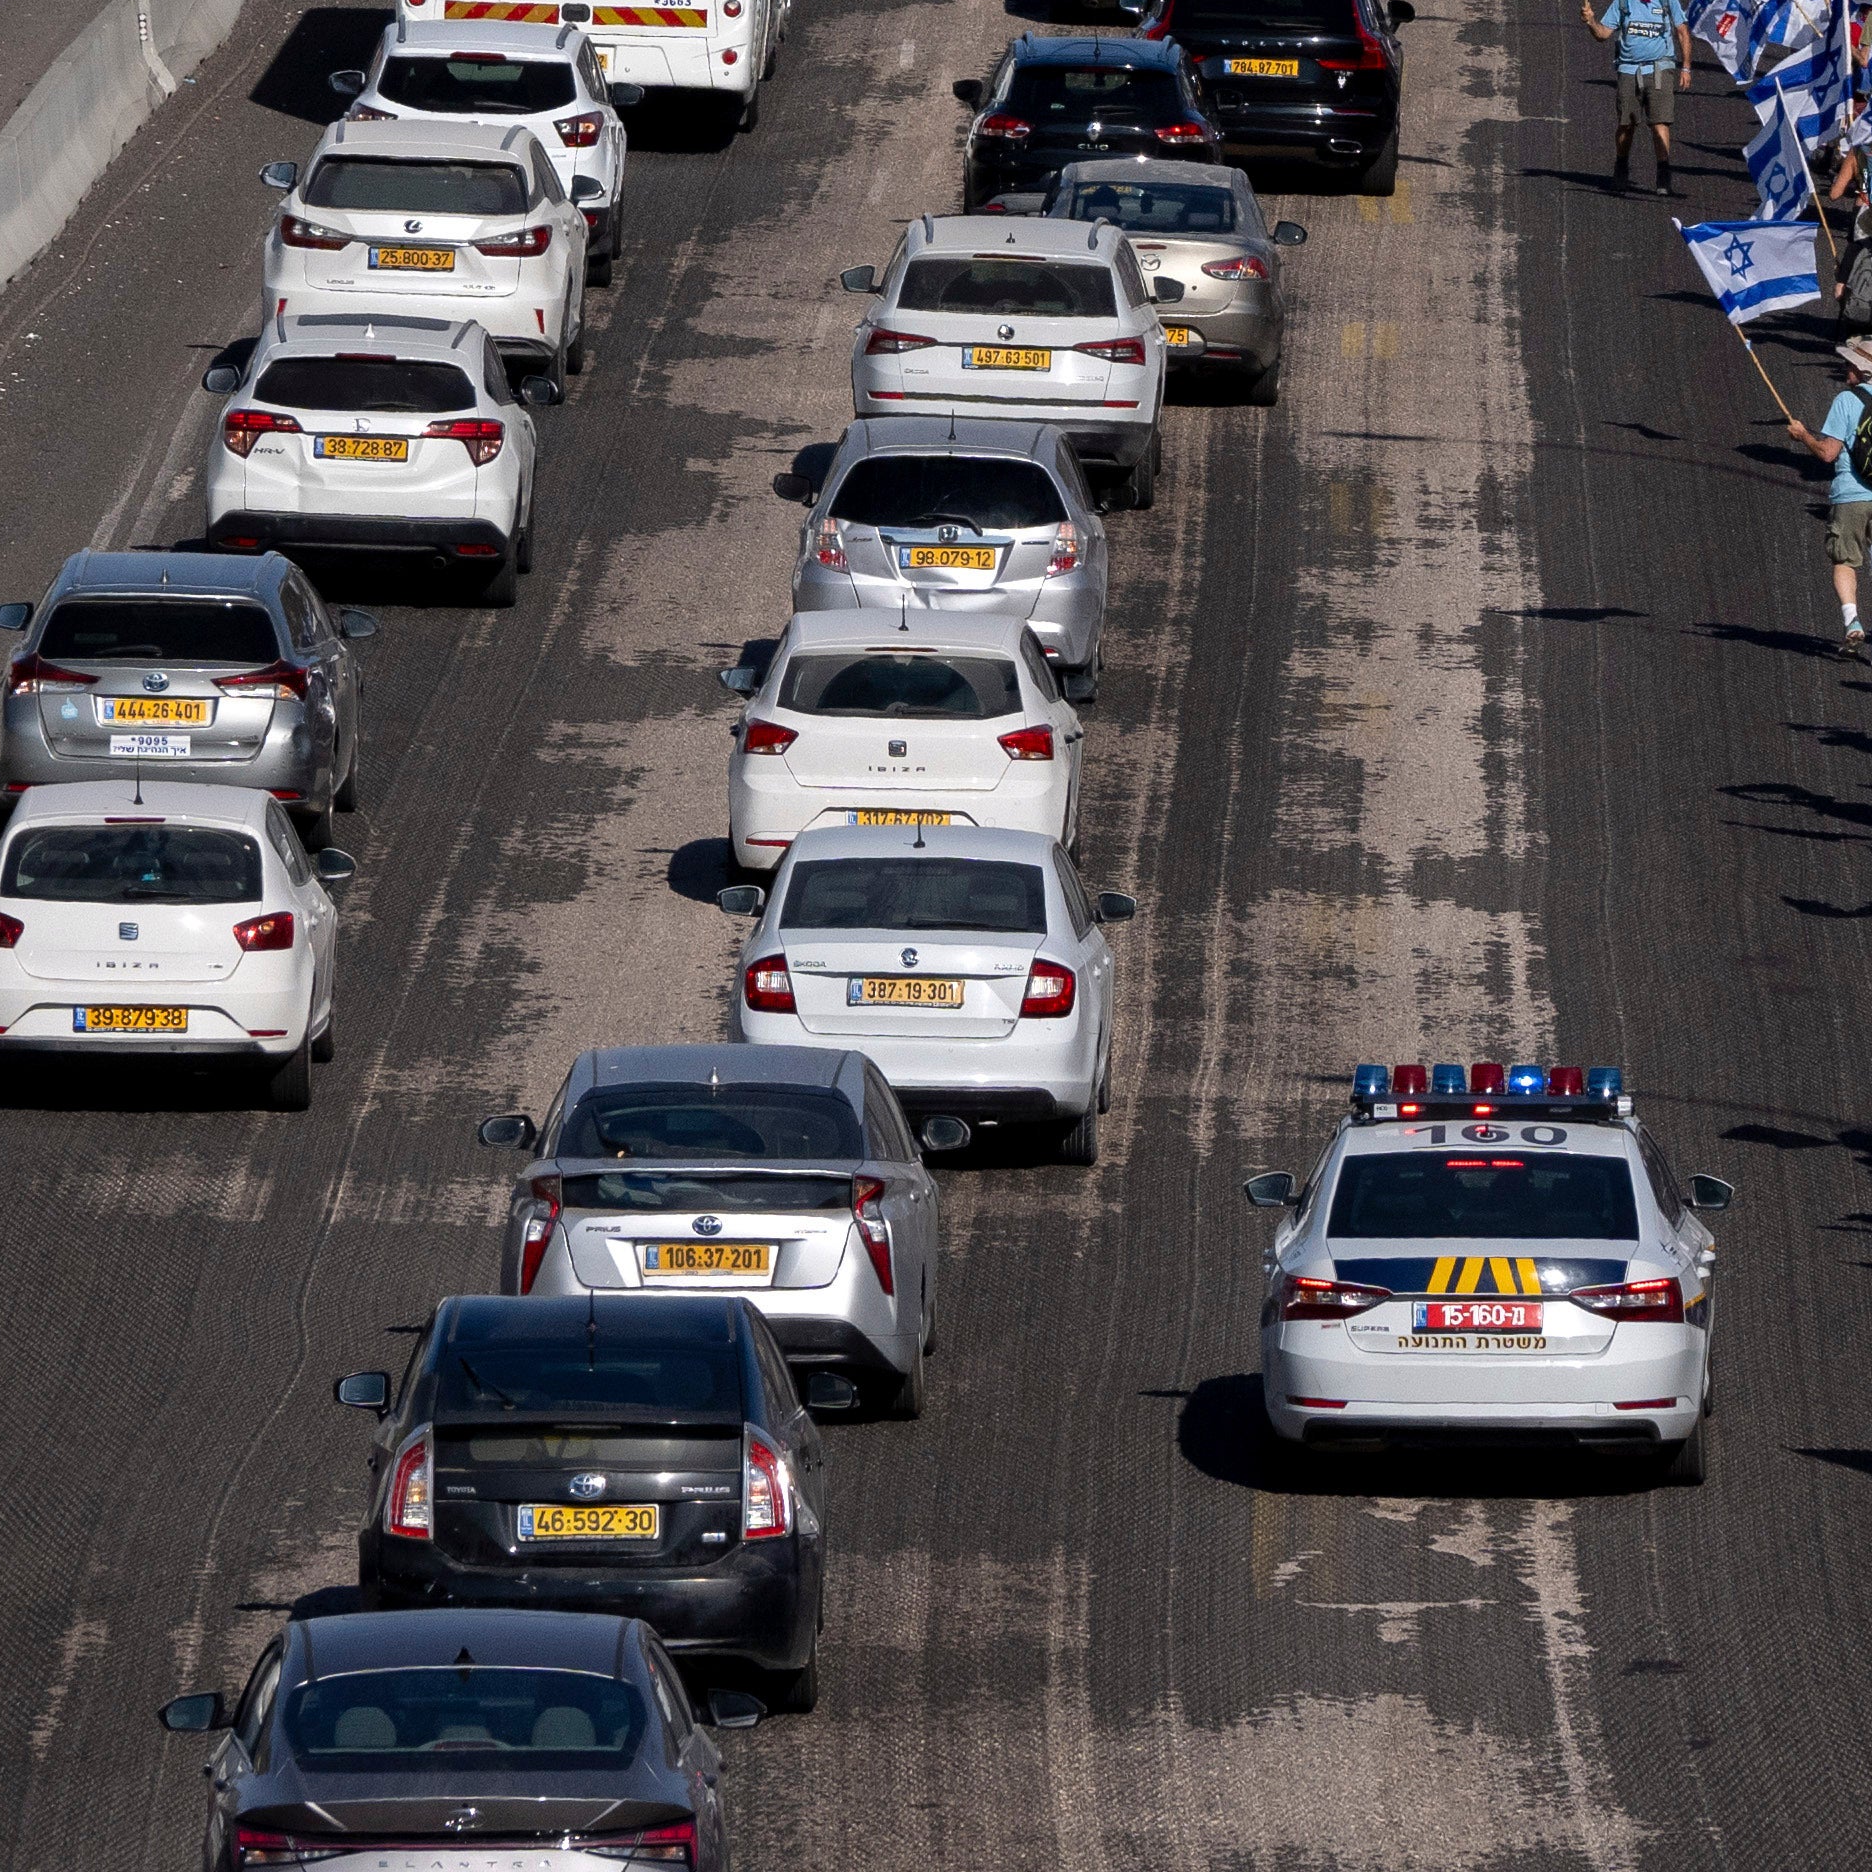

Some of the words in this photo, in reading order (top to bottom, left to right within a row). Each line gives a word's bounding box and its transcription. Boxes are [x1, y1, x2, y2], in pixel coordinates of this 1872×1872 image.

[1077, 143, 1109, 151] CLIO
[1412, 1124, 1569, 1146] 160
[1350, 1324, 1390, 1333] SUPERB
[1397, 1335, 1467, 1350] התנועה
[1476, 1335, 1547, 1350] משטרת
[446, 1486, 477, 1494] TOYOTA
